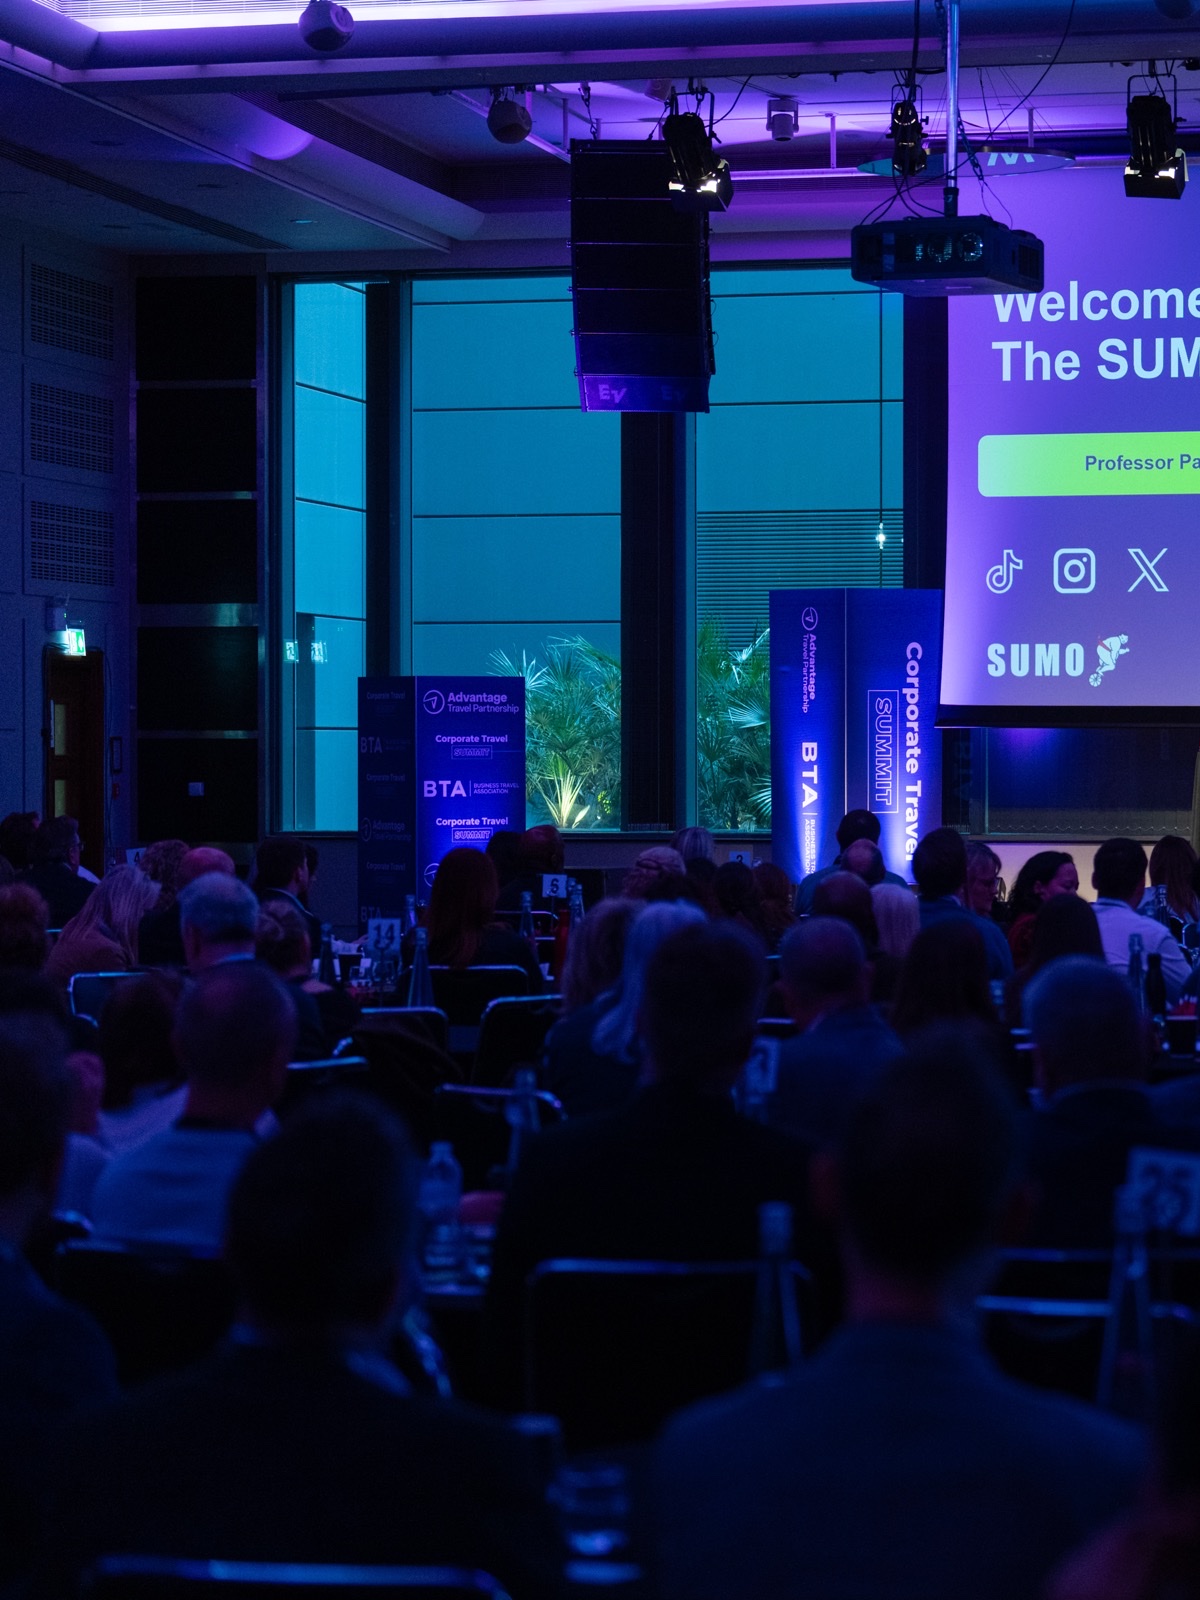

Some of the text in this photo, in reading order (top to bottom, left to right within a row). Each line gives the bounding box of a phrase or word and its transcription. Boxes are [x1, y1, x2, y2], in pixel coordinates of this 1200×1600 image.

[992, 341, 1081, 382] The
[1085, 454, 1174, 472] Professor
[987, 642, 1085, 678] SUMO
[447, 692, 507, 704] Advantage
[448, 703, 519, 714] Travel Partnership
[902, 642, 922, 773] Corporate
[435, 734, 508, 744] Corporate Travel
[876, 697, 892, 805] SUMMIT
[802, 742, 818, 808] BTA
[423, 780, 467, 797] BTA
[436, 817, 508, 827] Corporate Travel
[454, 831, 490, 839] SUMMIT
[374, 923, 395, 945] 14
